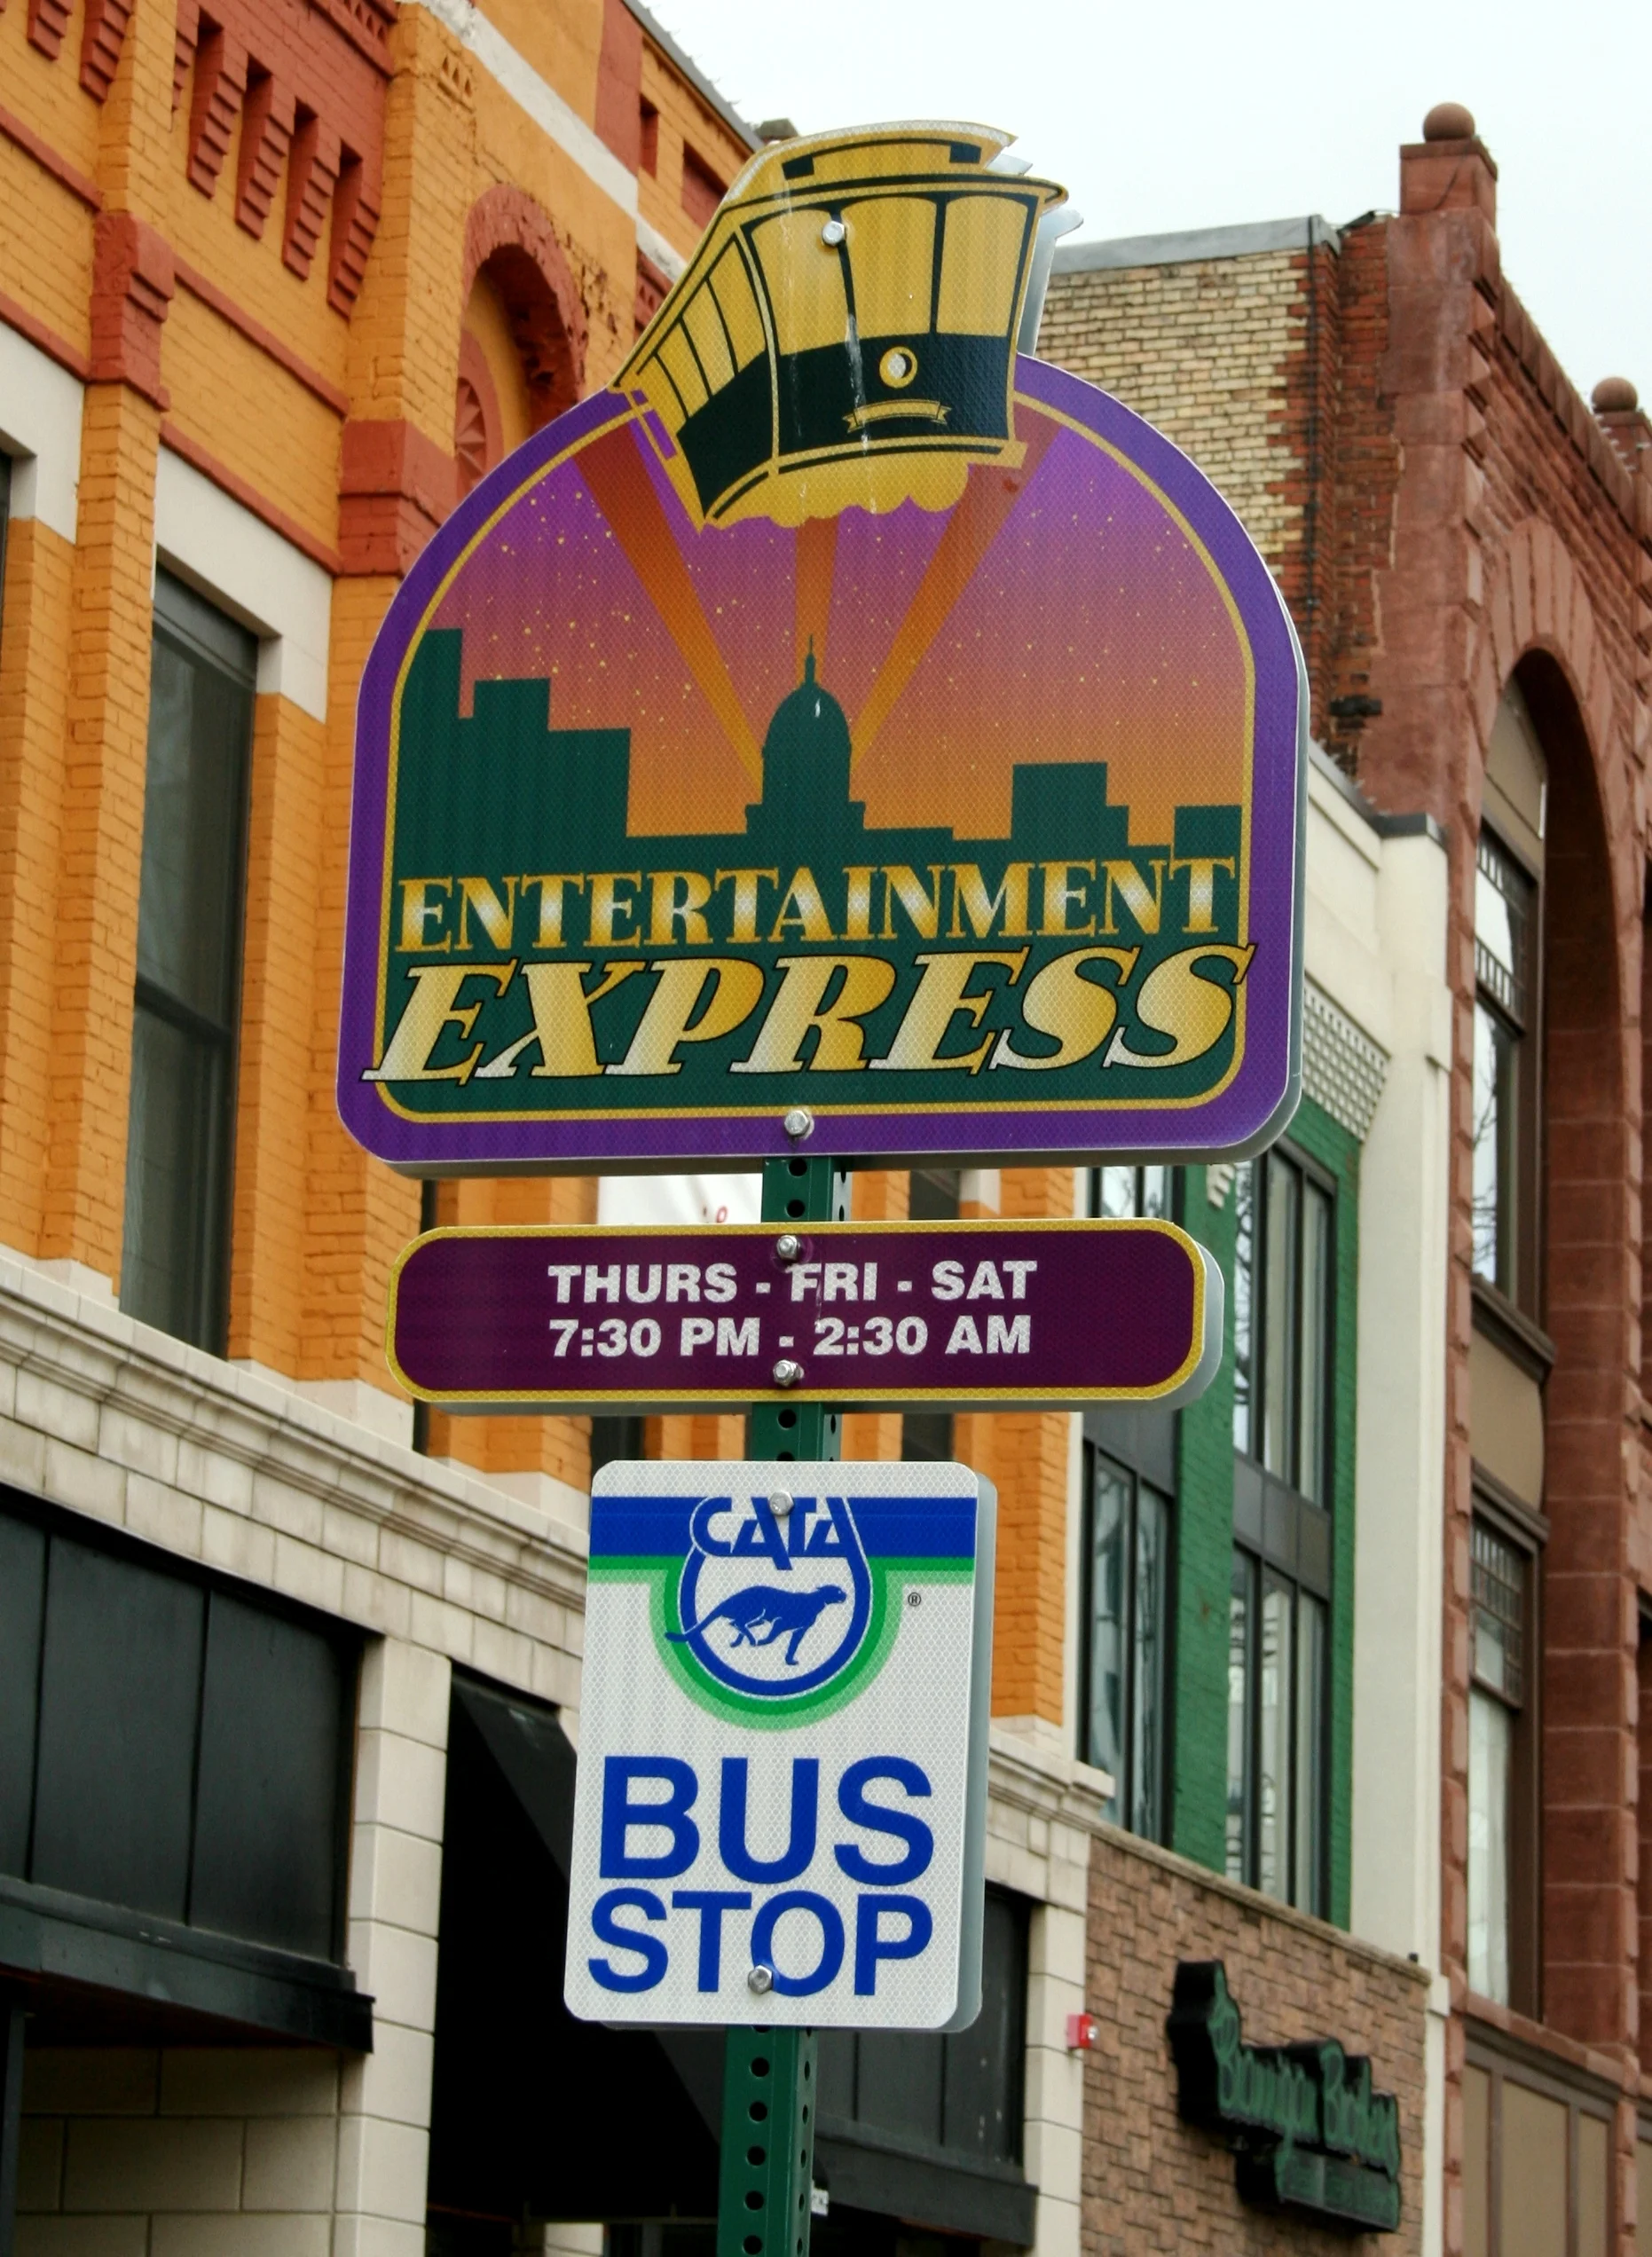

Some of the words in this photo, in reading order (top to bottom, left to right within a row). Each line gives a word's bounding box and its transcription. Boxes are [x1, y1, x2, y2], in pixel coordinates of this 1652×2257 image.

[395, 856, 1235, 953] ENTERTAINMENT
[359, 943, 1258, 1088] EXPRESS
[547, 1262, 737, 1303] THURS
[788, 1262, 878, 1302] FRI
[932, 1260, 1038, 1301] SAT
[549, 1318, 662, 1357] 7:30
[680, 1317, 760, 1357] PM
[813, 1316, 928, 1356] 2:30
[945, 1315, 1031, 1355] AM
[691, 1496, 862, 1571] CATA
[599, 1756, 934, 1886] BUS
[588, 1887, 933, 1997] STOP
